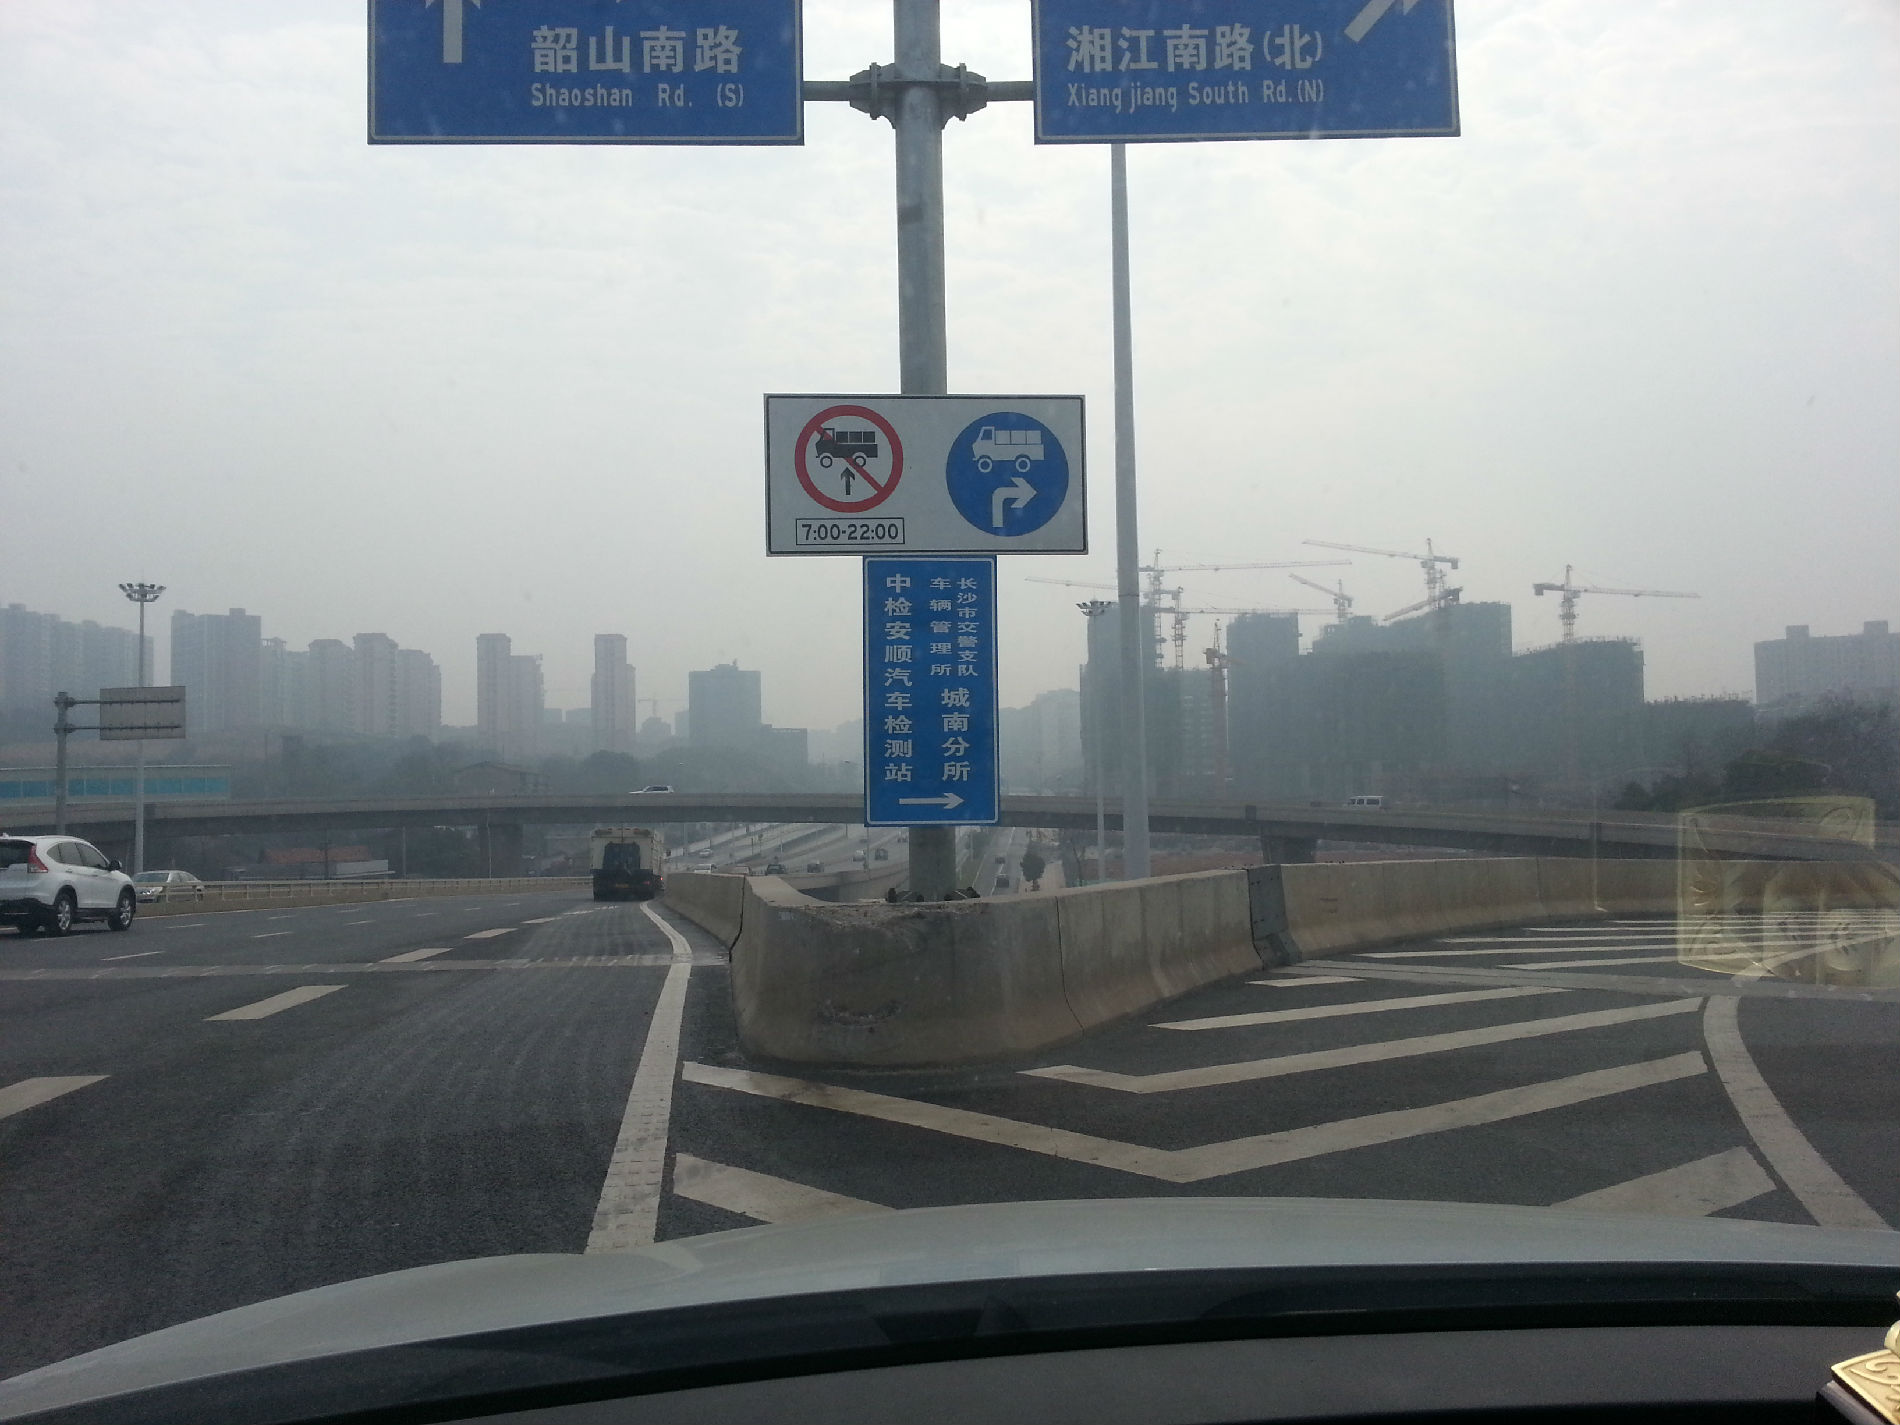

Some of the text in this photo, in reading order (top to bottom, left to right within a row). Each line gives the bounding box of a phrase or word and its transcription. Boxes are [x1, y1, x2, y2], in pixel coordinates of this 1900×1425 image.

[531, 25, 743, 74] 韶山南路
[1065, 24, 1323, 73] 湘江南路(北)
[531, 83, 745, 107] Shaoshan Rd. (S)
[1188, 80, 1249, 106] South
[801, 523, 899, 541] 7:00-22:00
[929, 577, 953, 676] 车辆管理所
[957, 577, 980, 677] 长沙市交警支队
[884, 573, 913, 782] 中检安顺汽车检测站
[941, 687, 971, 782] 城南分所
